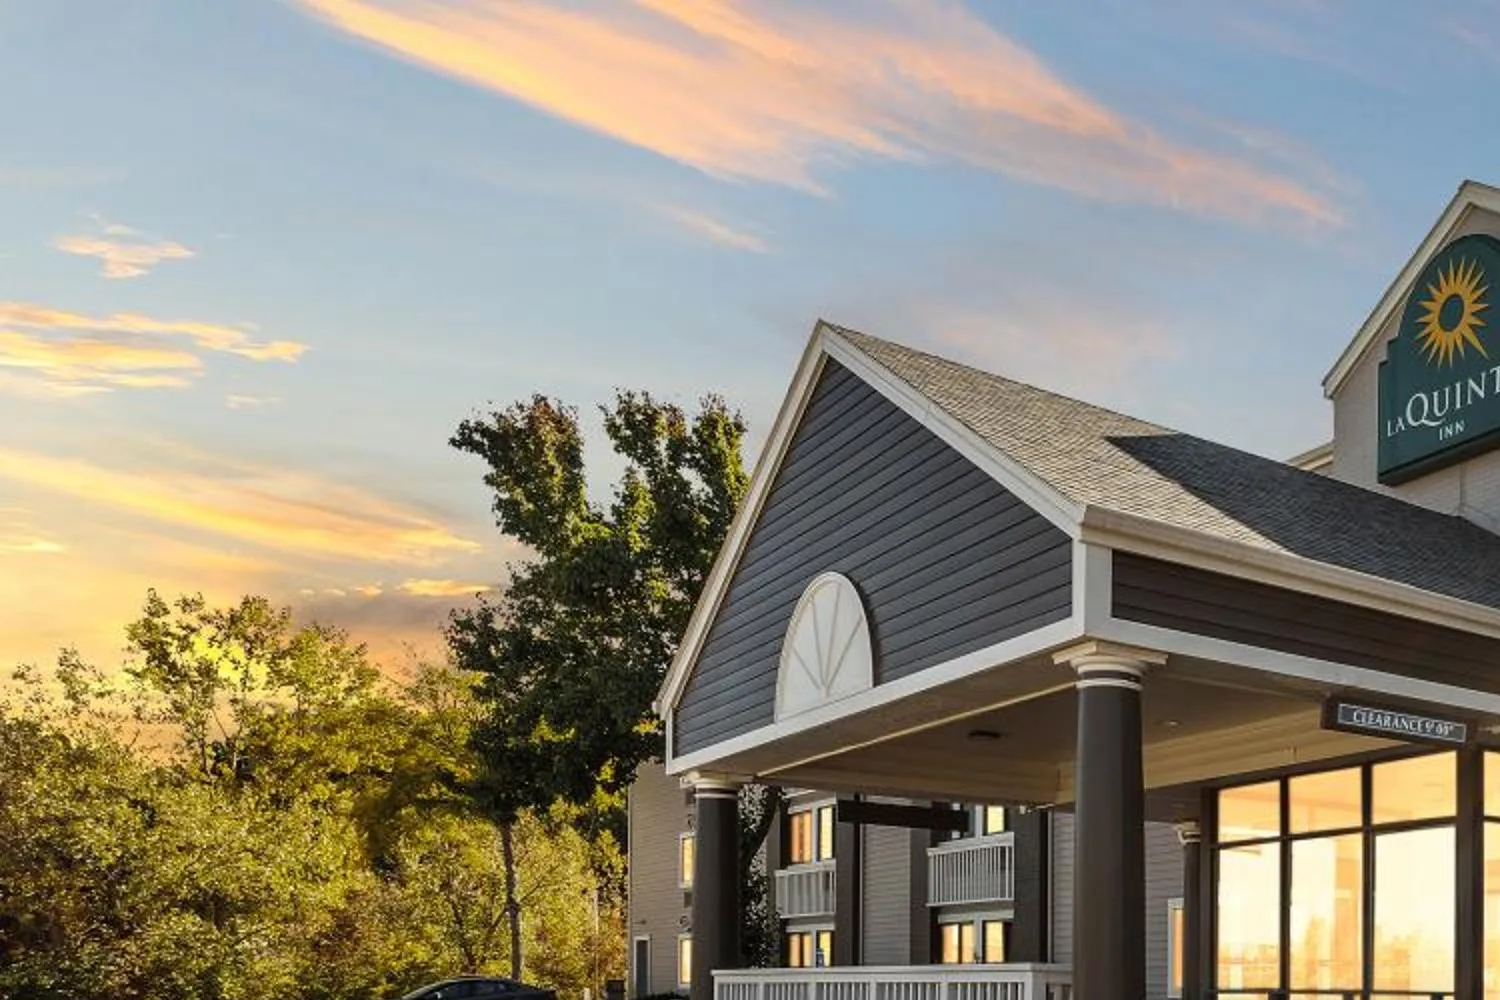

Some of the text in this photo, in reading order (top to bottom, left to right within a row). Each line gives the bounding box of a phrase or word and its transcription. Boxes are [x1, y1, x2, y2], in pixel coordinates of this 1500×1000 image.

[1386, 416, 1406, 437] LA
[1438, 419, 1466, 441] INN
[1352, 710, 1424, 733] CLEARANCE
